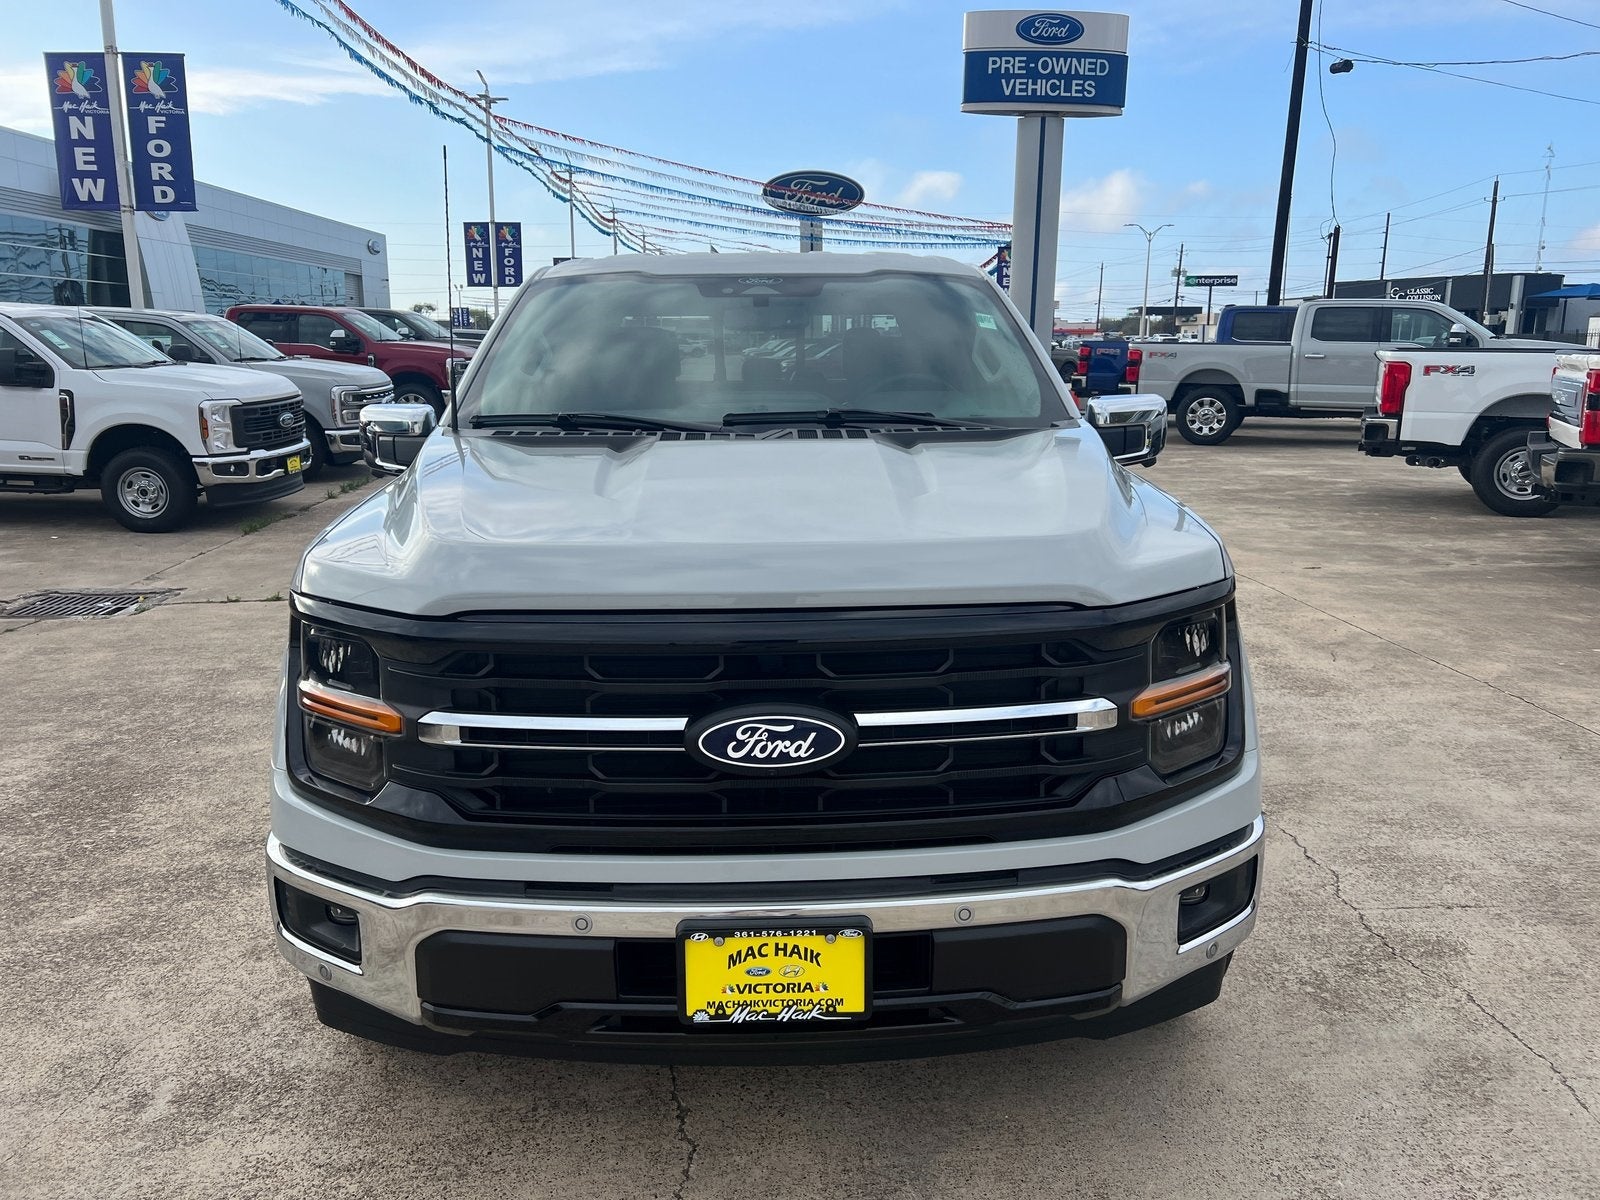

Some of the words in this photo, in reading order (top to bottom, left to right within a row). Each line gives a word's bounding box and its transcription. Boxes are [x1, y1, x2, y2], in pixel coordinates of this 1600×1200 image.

[1030, 17, 1070, 38] Ford
[1001, 78, 1096, 98] VEHICLES
[68, 115, 106, 202] NEW
[146, 115, 176, 204] FORD
[472, 247, 486, 284] NEW
[503, 248, 515, 285] FORD
[1189, 277, 1237, 285] enterprise
[1406, 287, 1434, 295] CLASSIC
[1149, 351, 1177, 359] FX4
[1422, 364, 1476, 377] FX4
[726, 723, 817, 758] Ford
[734, 929, 818, 938] 361-576-1221
[727, 943, 769, 970] MAC
[774, 942, 822, 967] HAIK
[735, 982, 815, 995] VICTORIA
[728, 1006, 775, 1024] Mac
[776, 1004, 828, 1022] Haik
